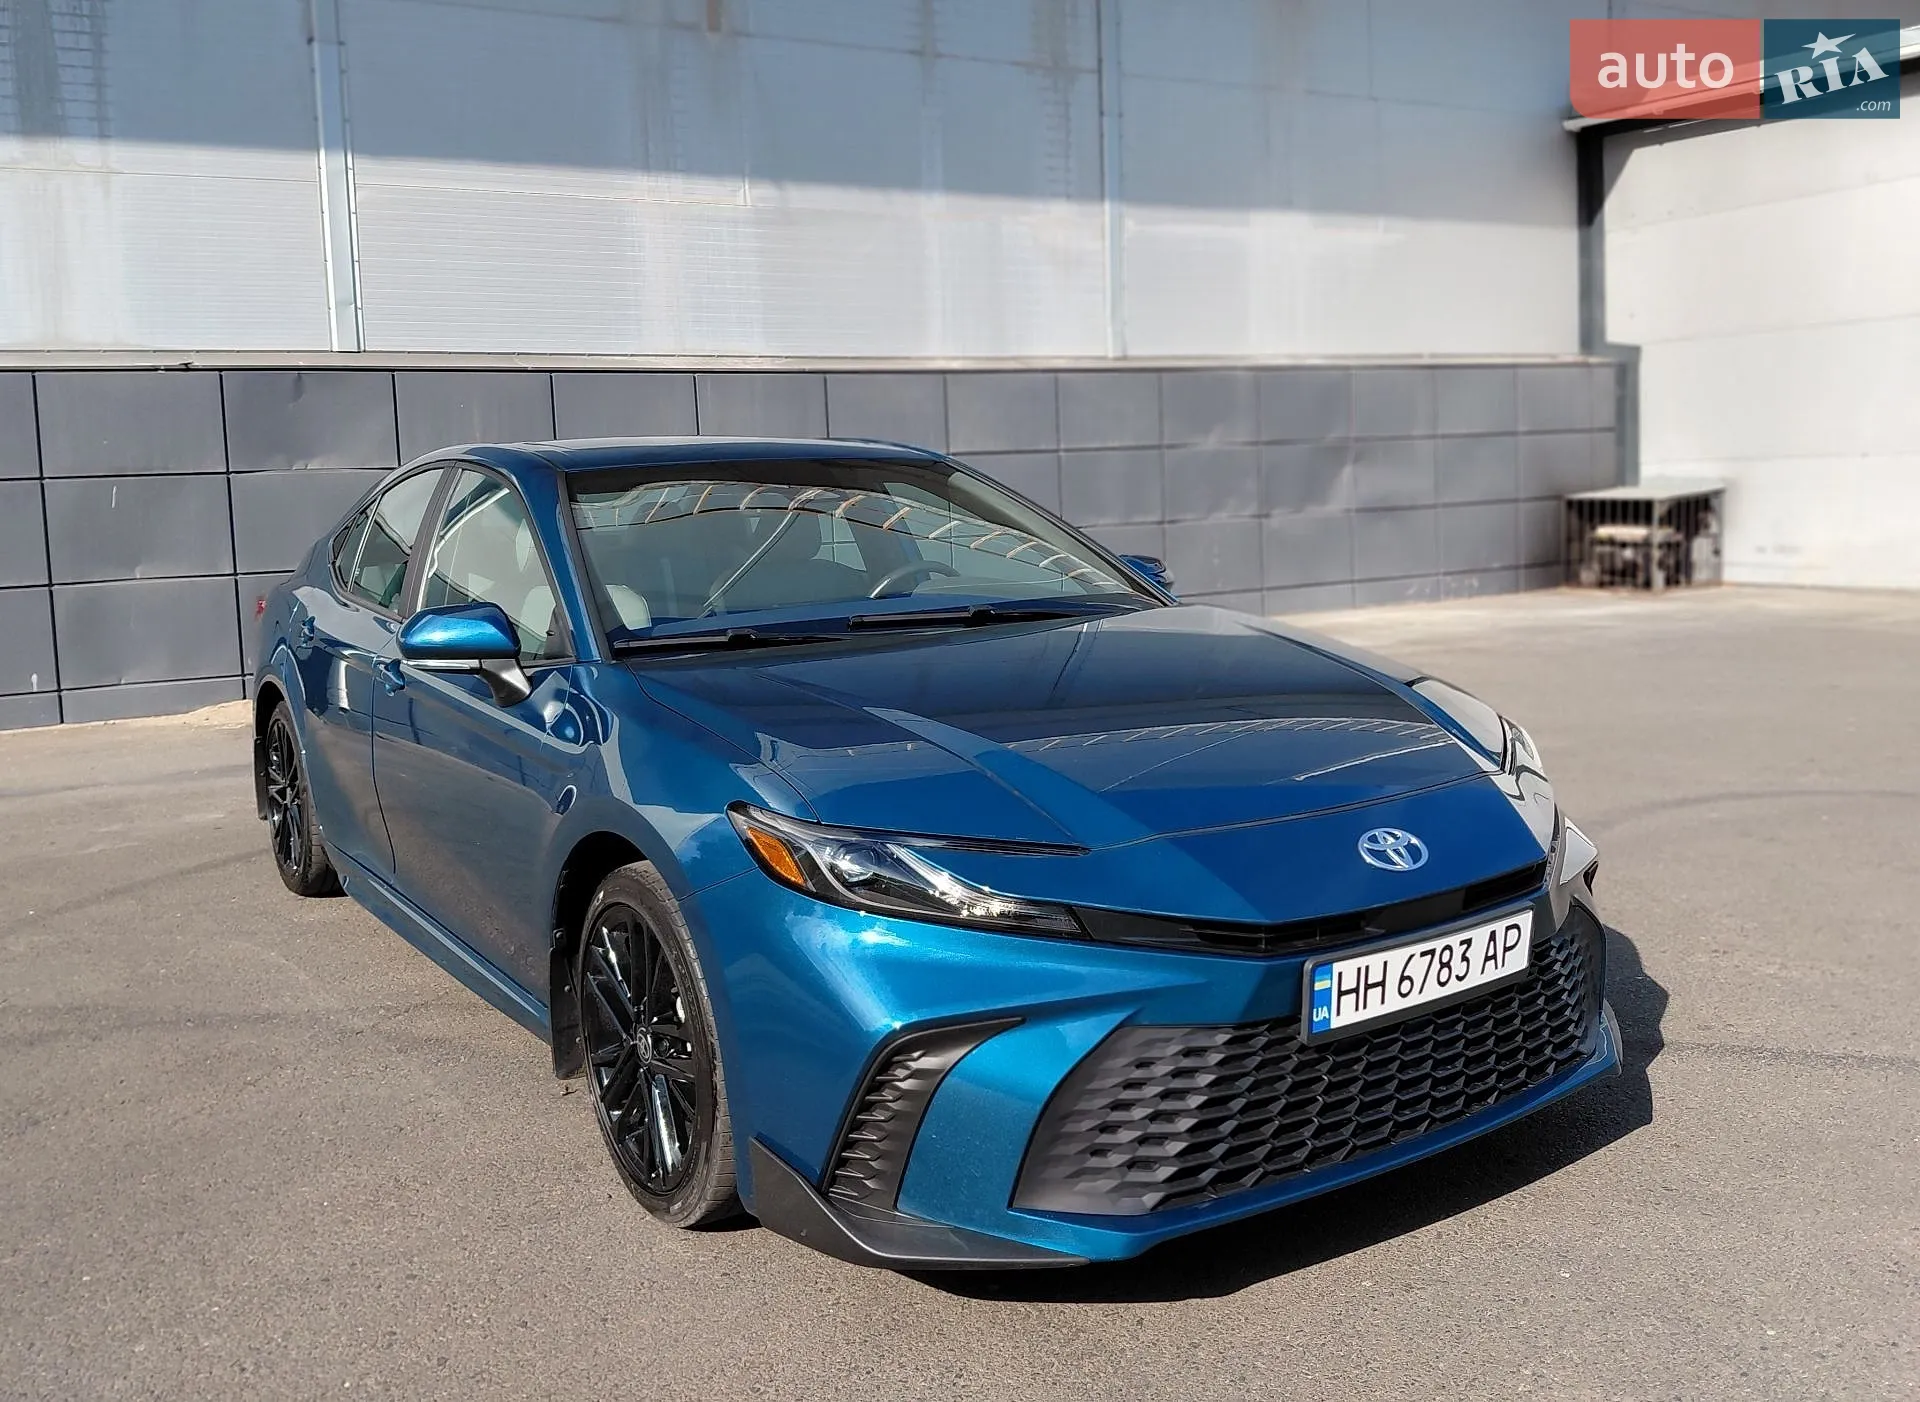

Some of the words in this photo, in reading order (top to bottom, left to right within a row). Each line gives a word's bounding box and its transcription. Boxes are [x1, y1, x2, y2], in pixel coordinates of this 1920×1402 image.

[1336, 960, 1388, 1016] HH
[1397, 937, 1473, 998] 6783
[1480, 923, 1521, 974] AP
[1312, 1007, 1329, 1022] UA
